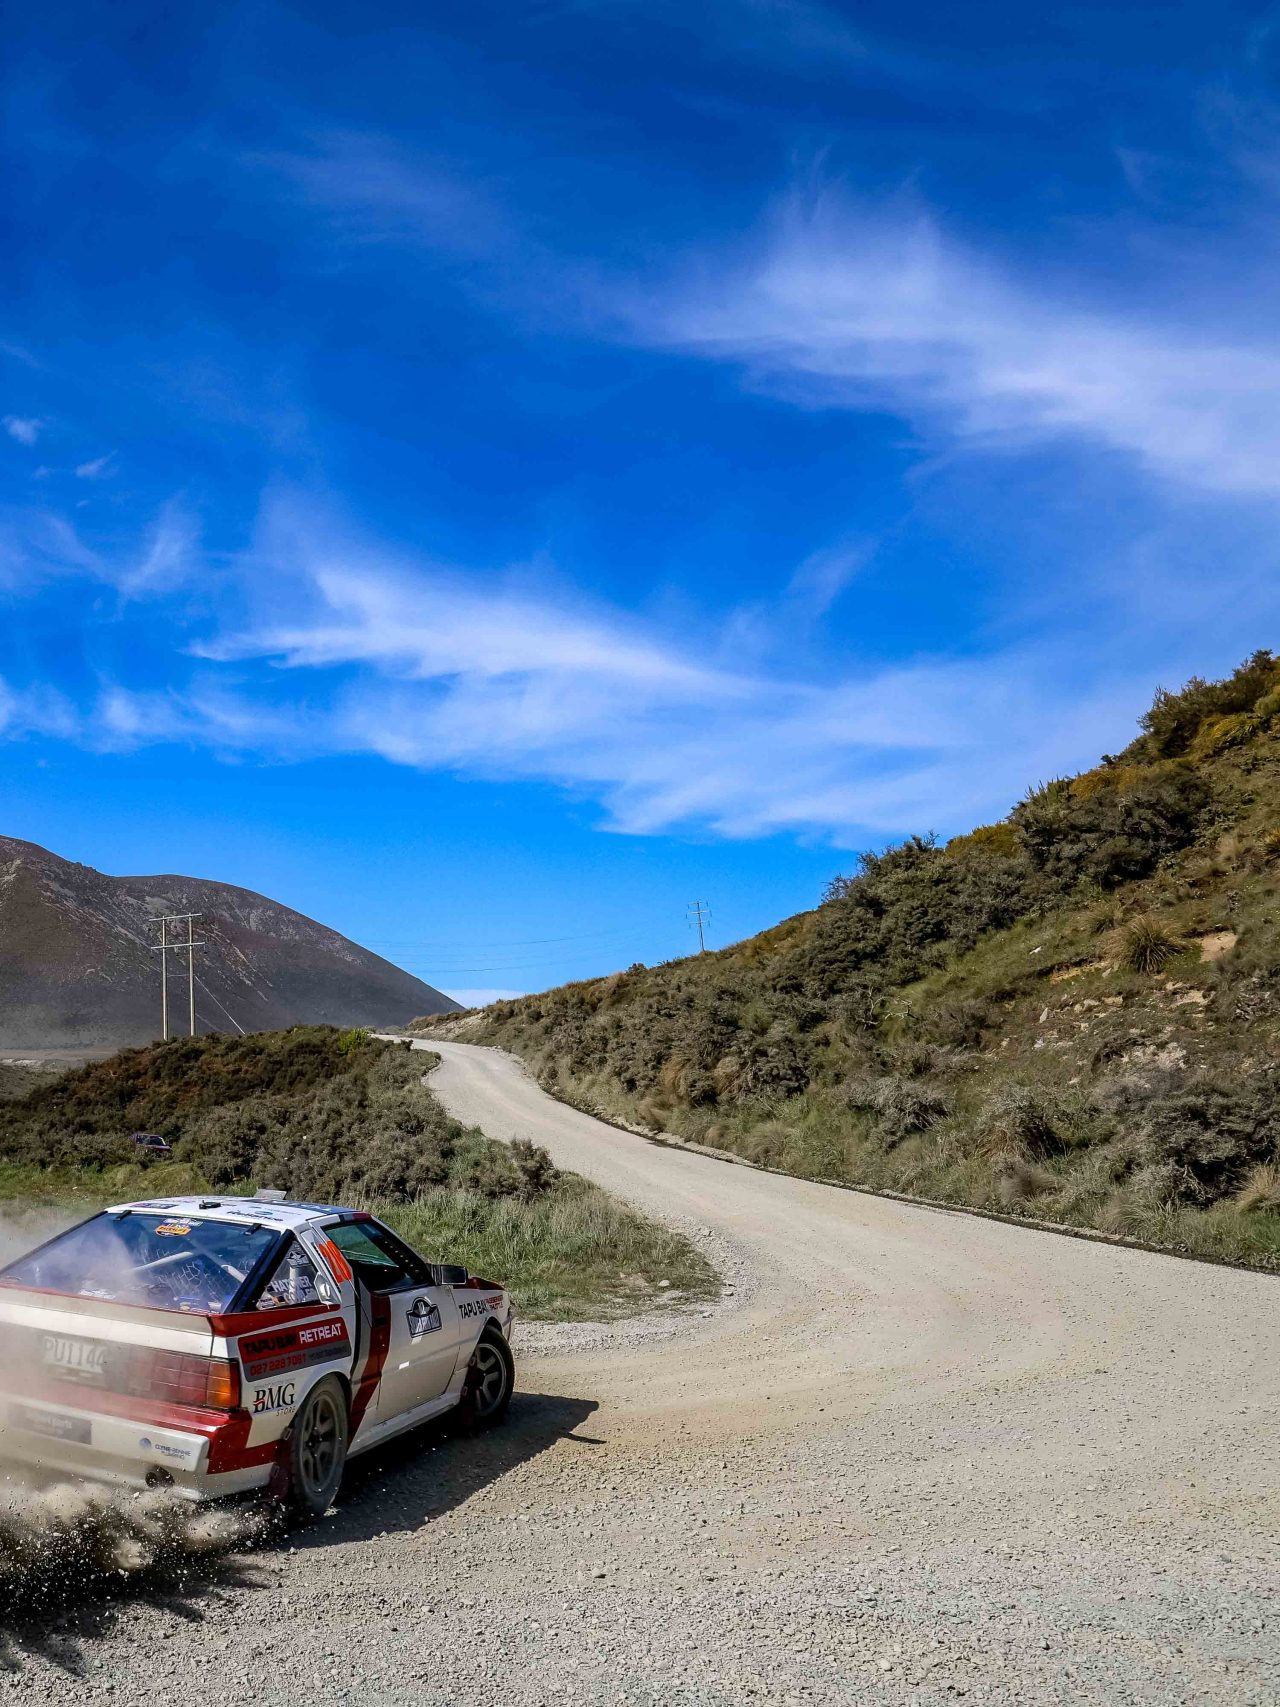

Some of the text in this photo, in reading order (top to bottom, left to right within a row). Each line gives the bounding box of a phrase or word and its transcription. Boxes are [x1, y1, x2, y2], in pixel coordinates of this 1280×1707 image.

[459, 1302, 478, 1320] TAPU
[299, 1322, 342, 1344] RETREAT
[253, 1382, 295, 1413] BMG
[276, 1405, 296, 1416] STORE
